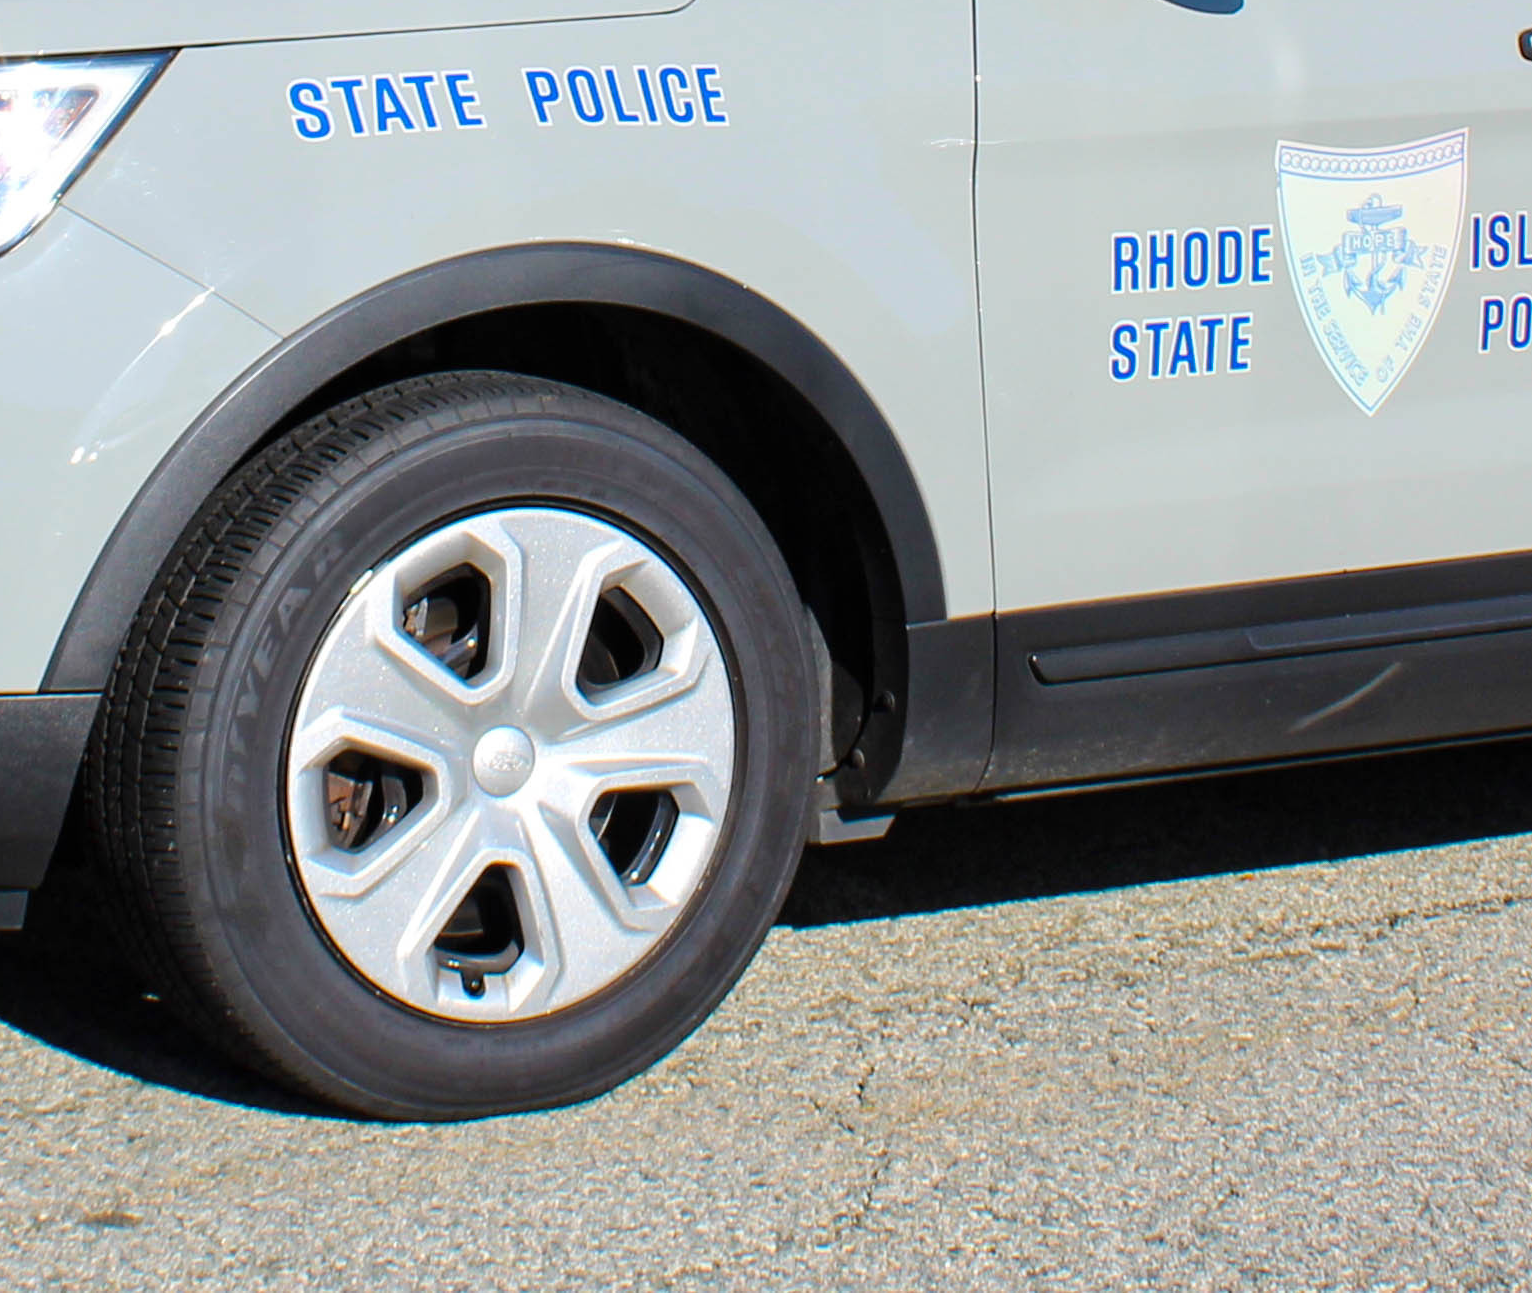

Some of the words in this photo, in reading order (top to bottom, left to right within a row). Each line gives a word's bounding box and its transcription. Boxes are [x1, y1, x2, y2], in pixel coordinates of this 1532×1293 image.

[288, 72, 485, 140] STATE
[524, 66, 728, 124] POLICE
[1113, 227, 1271, 292] RHODE
[1353, 233, 1396, 250] HOPE
[1111, 315, 1252, 380] STATE
